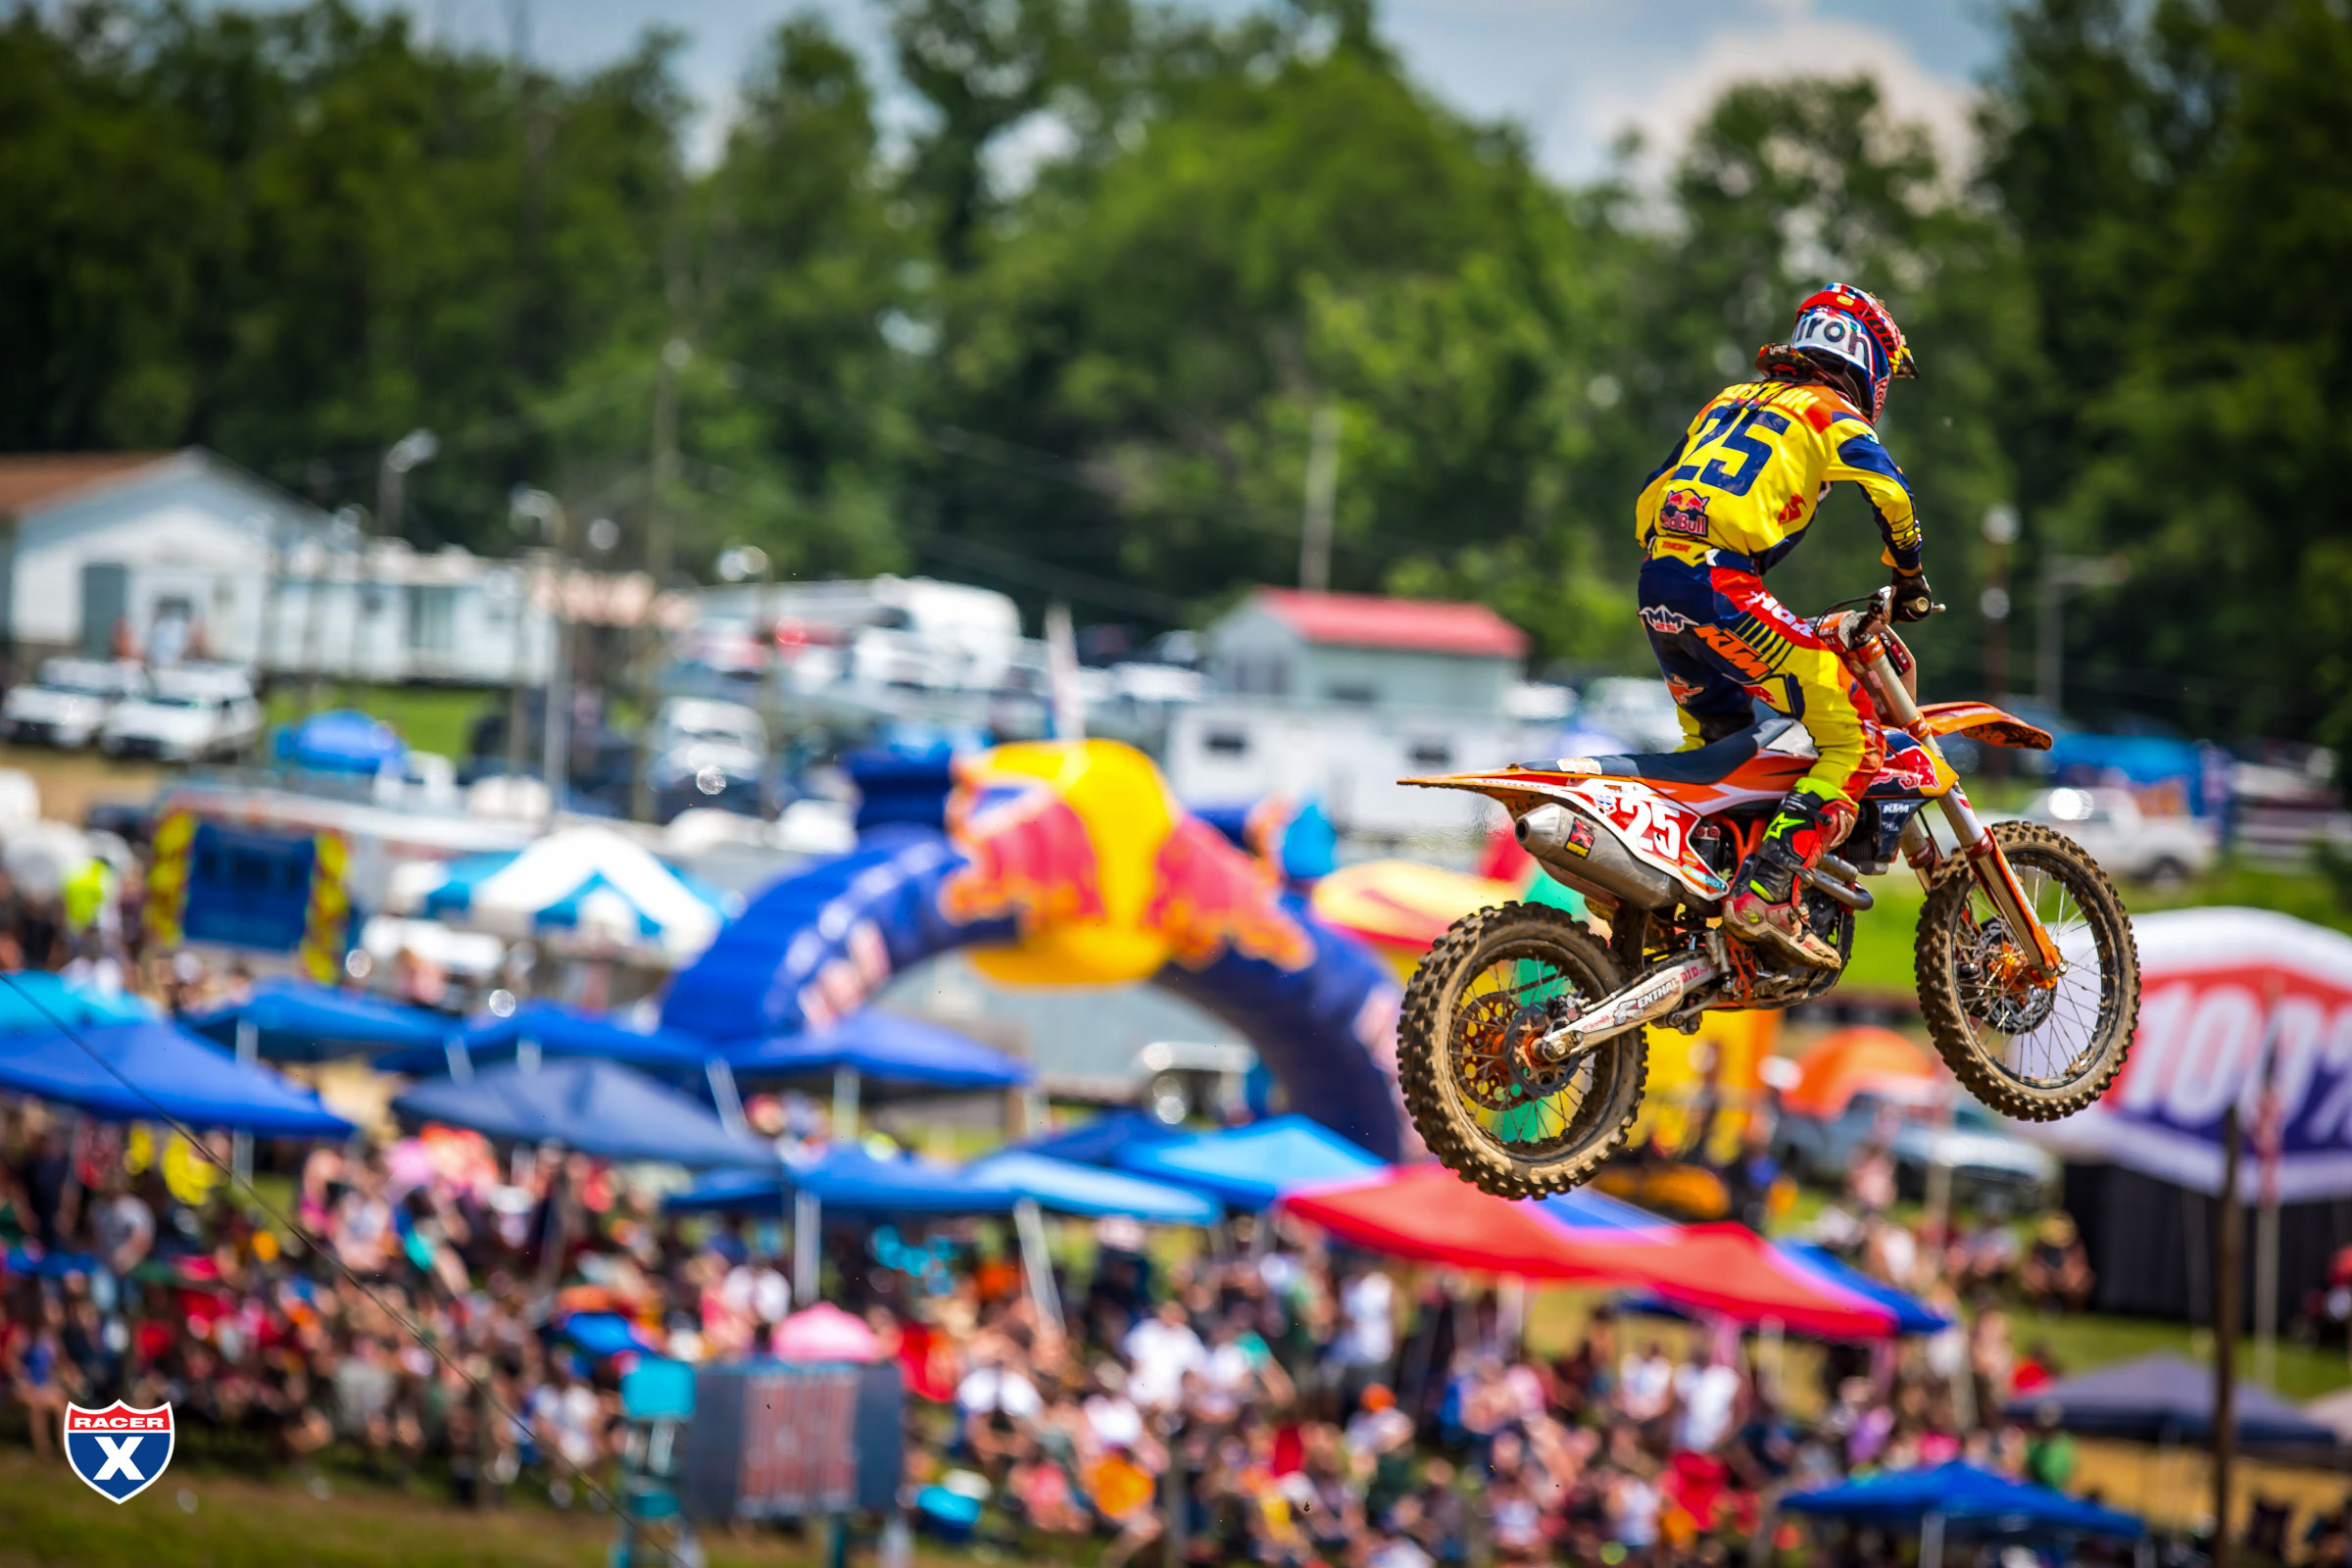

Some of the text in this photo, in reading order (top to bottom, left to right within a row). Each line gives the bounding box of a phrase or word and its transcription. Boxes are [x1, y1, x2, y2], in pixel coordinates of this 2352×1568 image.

[1791, 317, 1870, 370] iroh
[1670, 405, 1791, 497] 25
[1679, 512, 1707, 535] Bull
[1662, 540, 1692, 554] THOR
[1692, 624, 1773, 679] KTM
[1883, 803, 1910, 814] KTM
[1620, 796, 1681, 861] 25
[1680, 965, 1699, 984] DID
